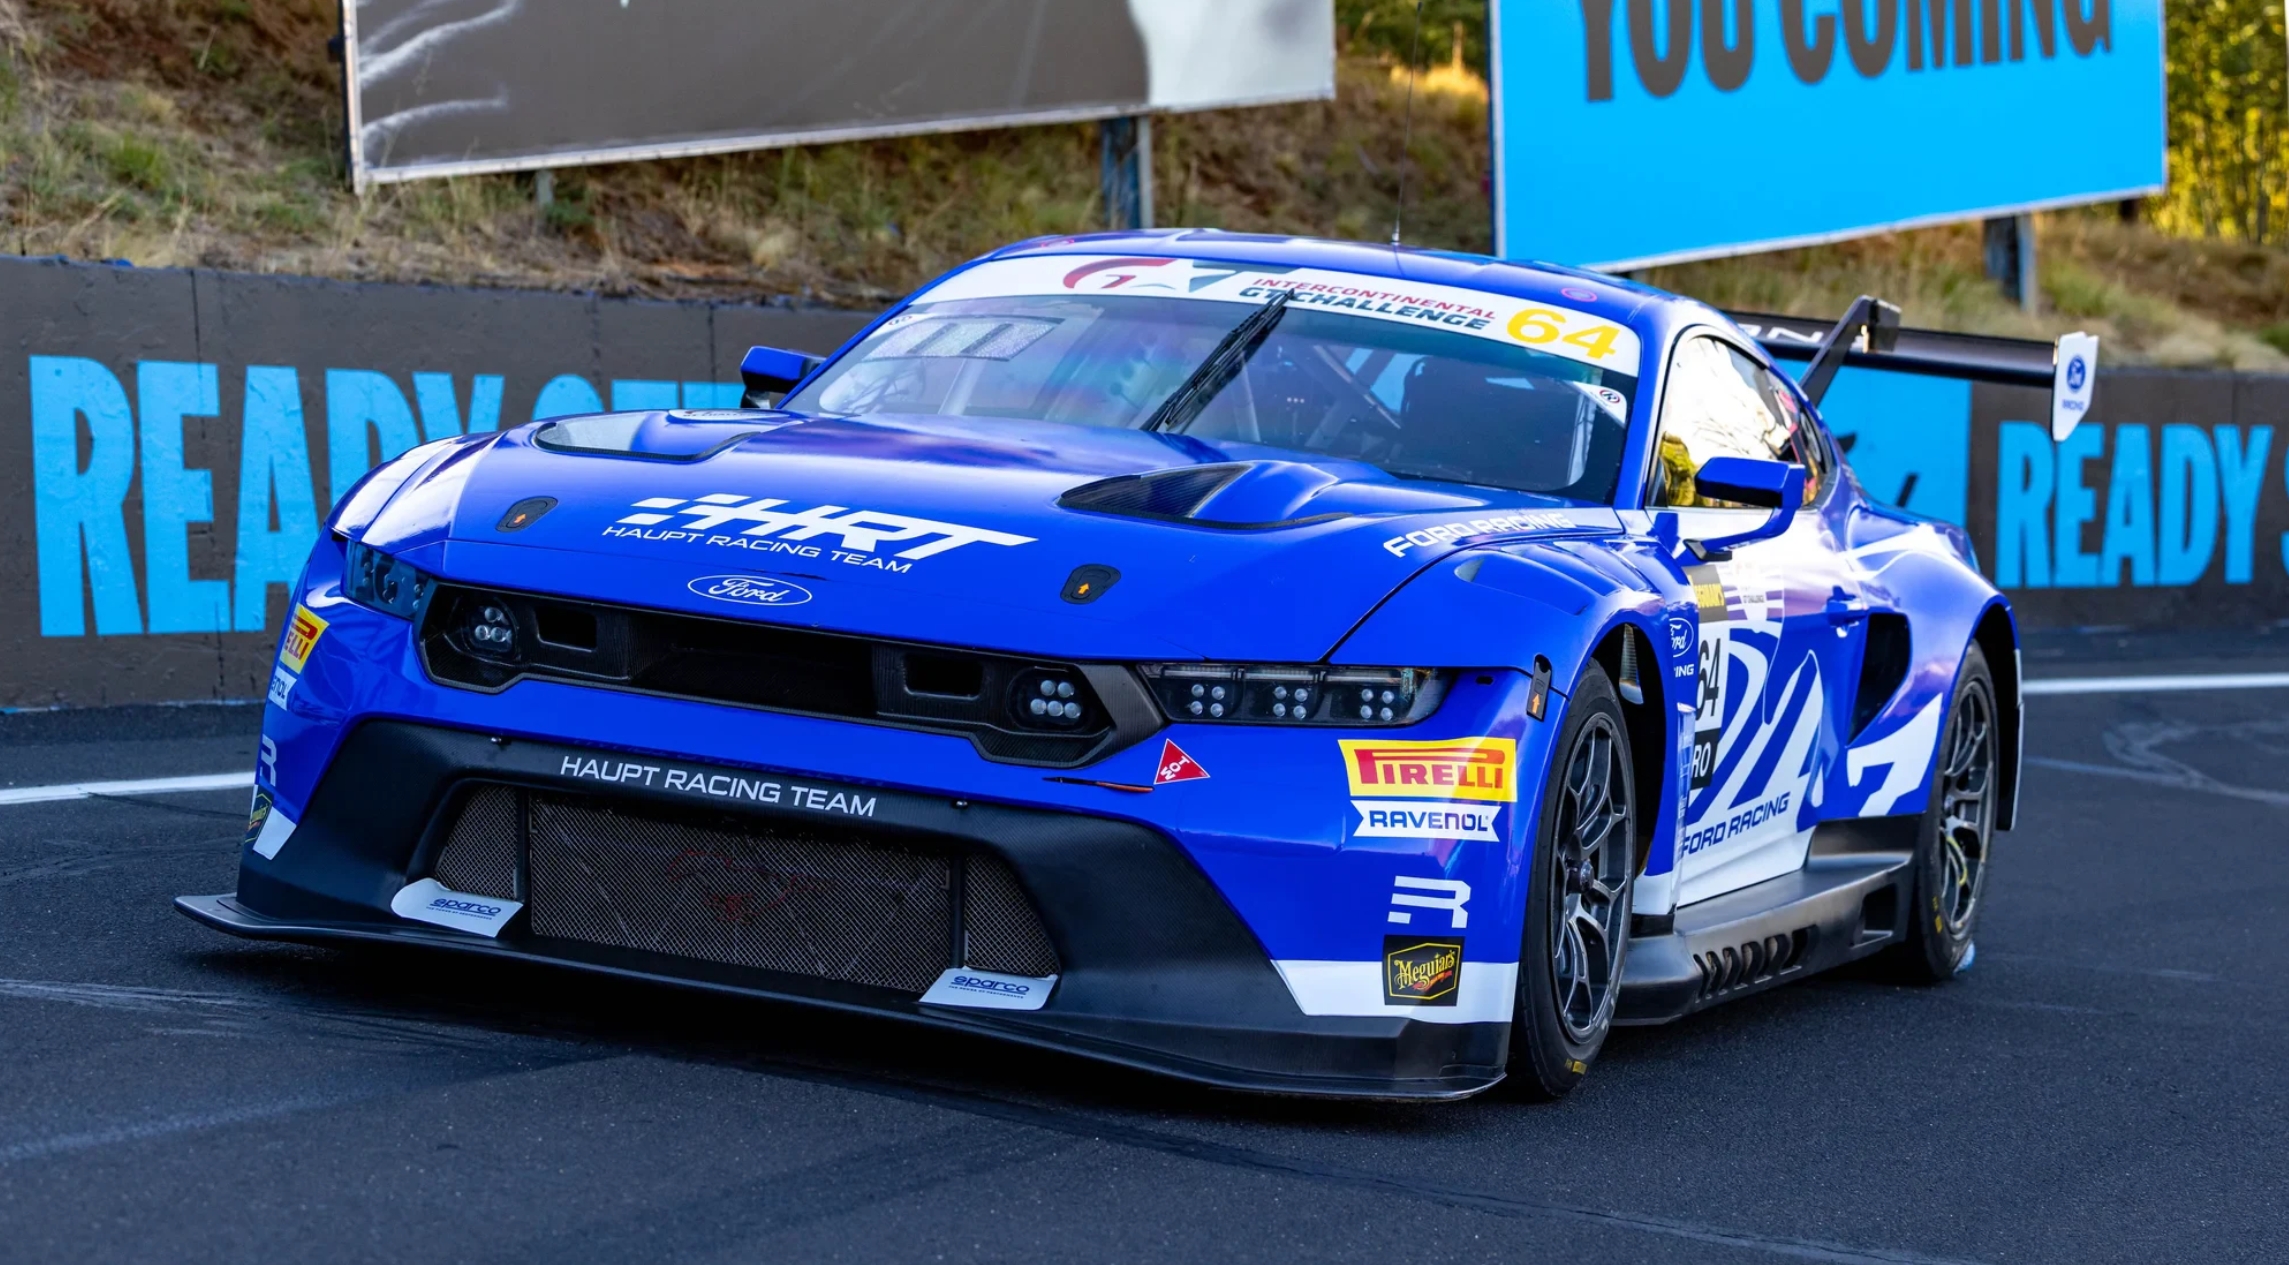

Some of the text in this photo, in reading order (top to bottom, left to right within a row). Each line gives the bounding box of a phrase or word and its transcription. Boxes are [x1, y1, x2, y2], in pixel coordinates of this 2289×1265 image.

[1252, 278, 1497, 320] INTERCONTINENTAL
[1293, 291, 1491, 331] CHALLENGE
[1507, 308, 1620, 359] 64
[29, 354, 505, 638] REA
[1994, 420, 2275, 588] READY
[602, 526, 912, 574] HAUPT RACING TEAM
[1383, 513, 1577, 558] FORD RACING
[708, 578, 790, 602] Ford
[1674, 664, 1694, 678] ING
[1695, 638, 1721, 721] 64
[560, 755, 877, 817] HAUPT RACING TEAM
[1160, 755, 1190, 781] TOW
[1354, 747, 1505, 789] PIRELLI
[1369, 810, 1489, 832] RAVENOL
[1681, 791, 1791, 858] FORD RACING
